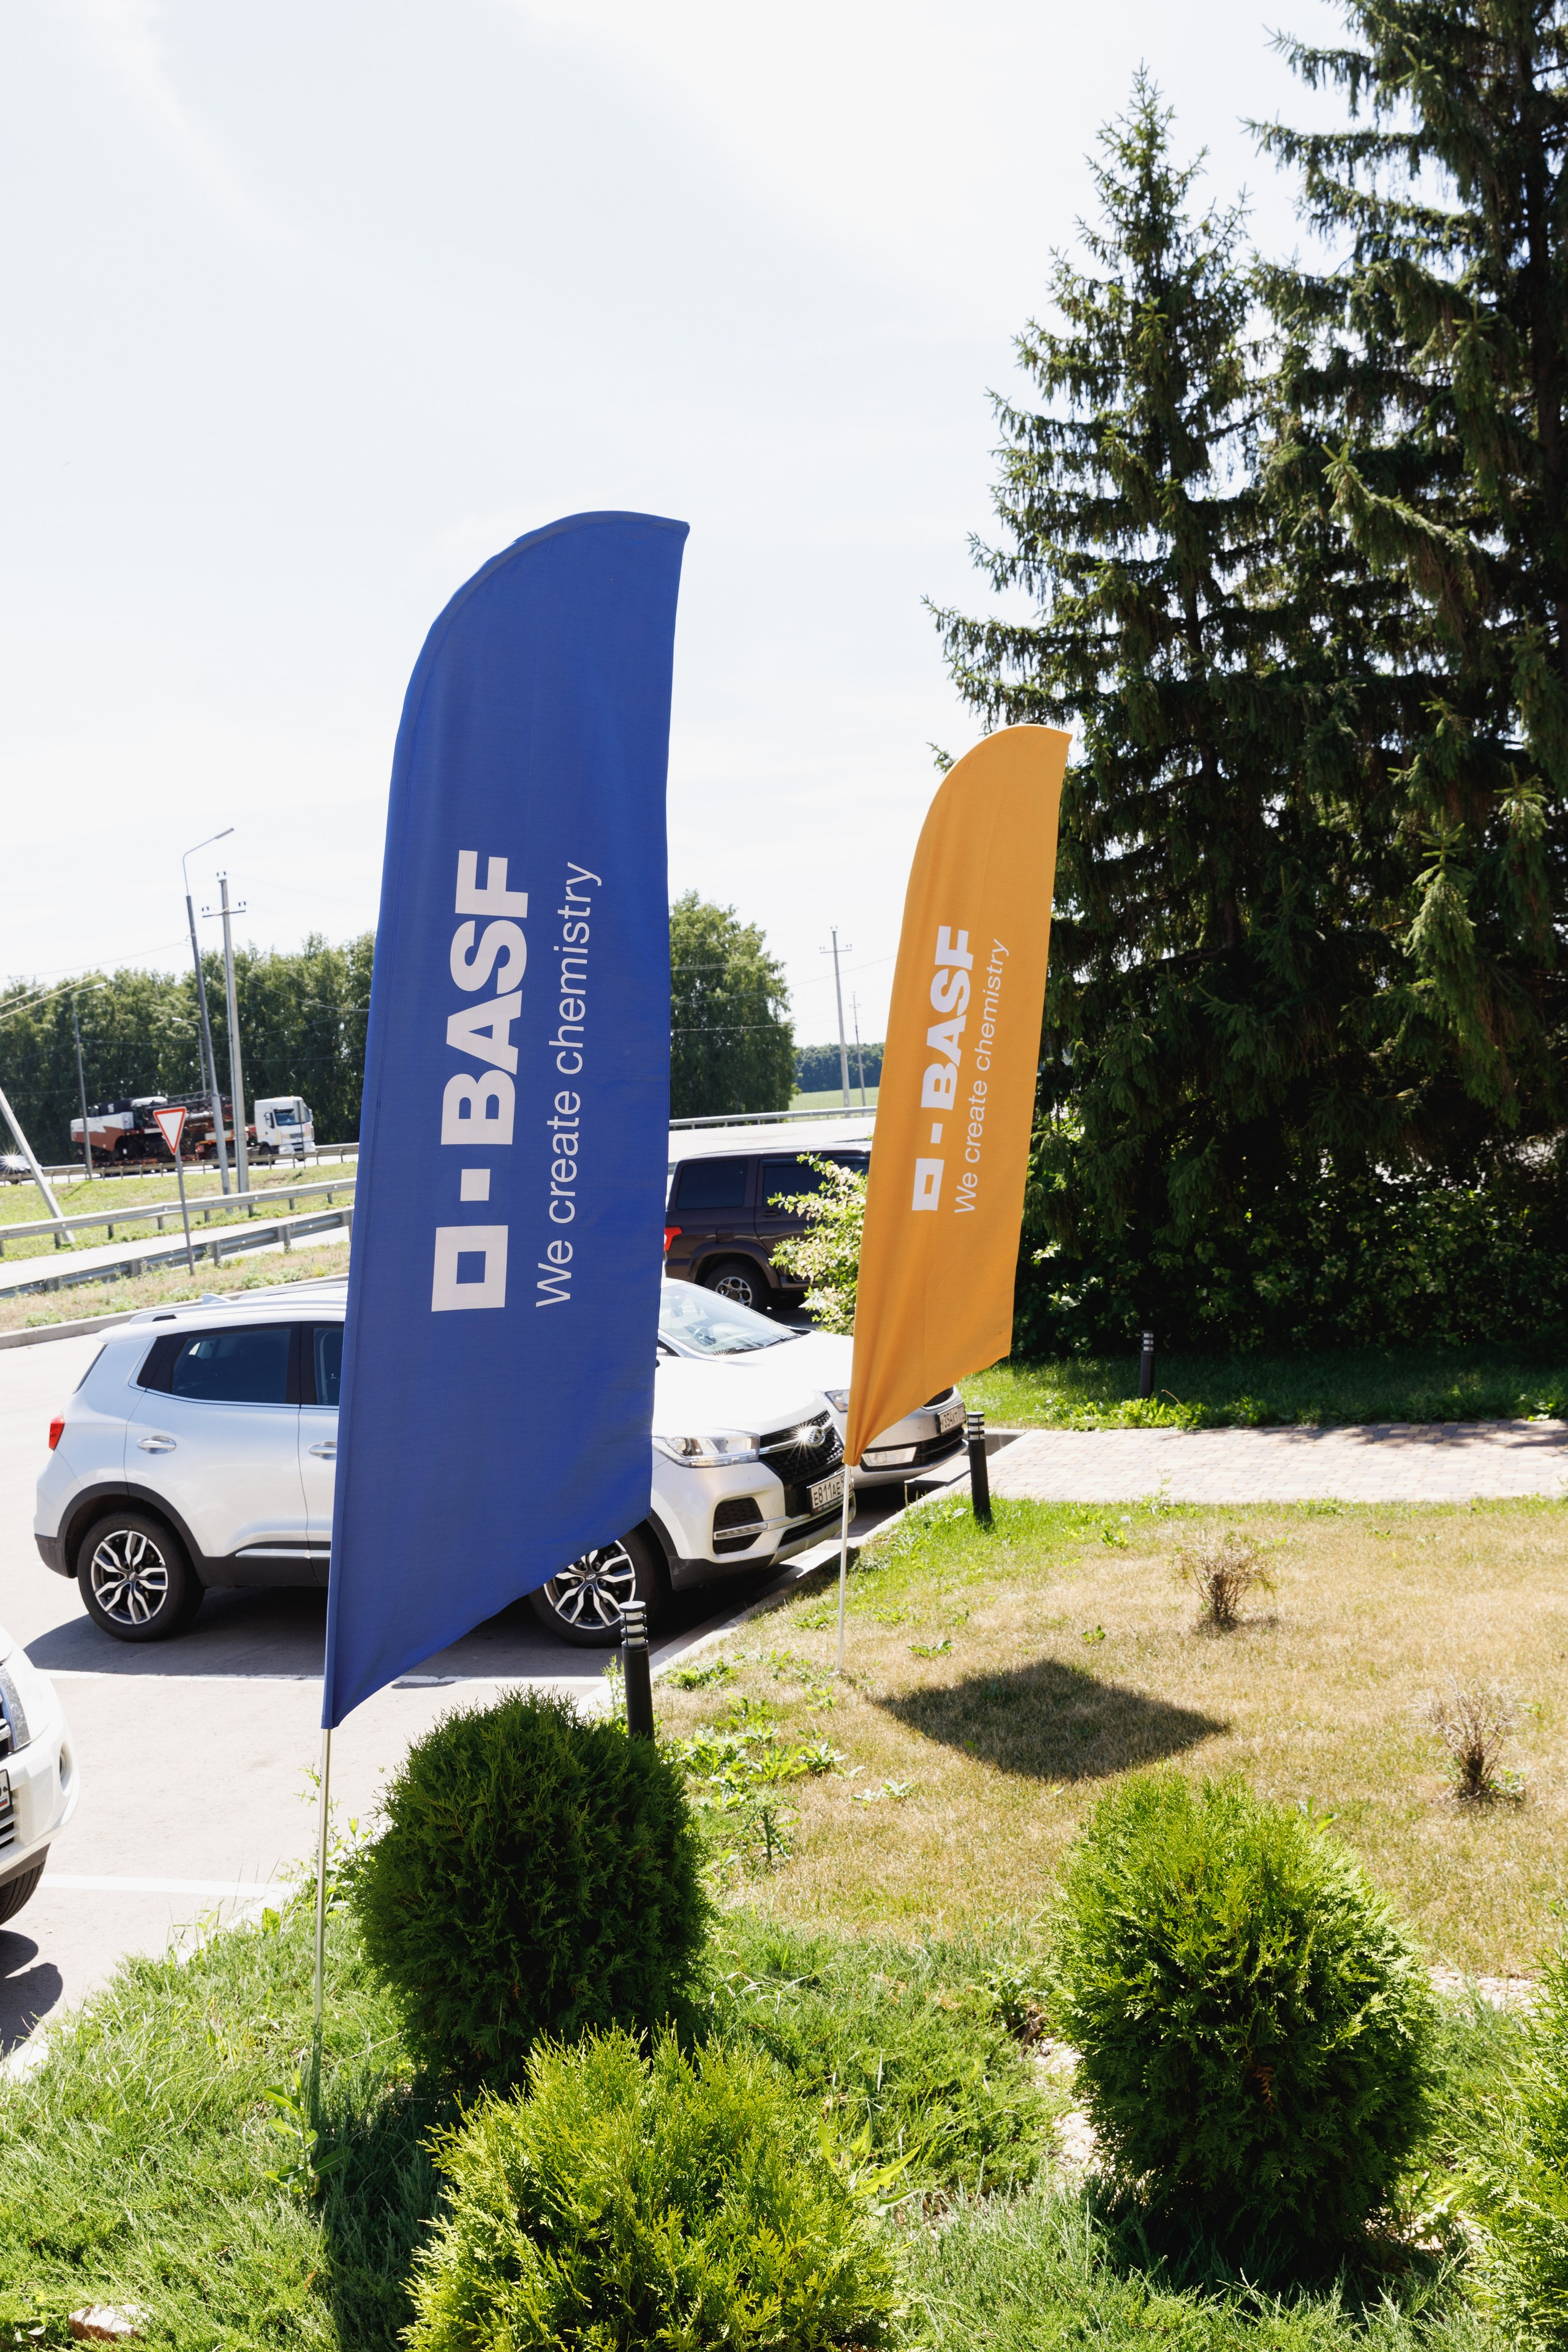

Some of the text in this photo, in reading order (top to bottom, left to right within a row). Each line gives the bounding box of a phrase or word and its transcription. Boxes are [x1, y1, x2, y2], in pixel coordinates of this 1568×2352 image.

[441, 850, 528, 1145] BASF
[536, 862, 601, 1307] We create chemistry
[921, 925, 973, 1110] BASF
[955, 939, 1009, 1213] We create chemistry
